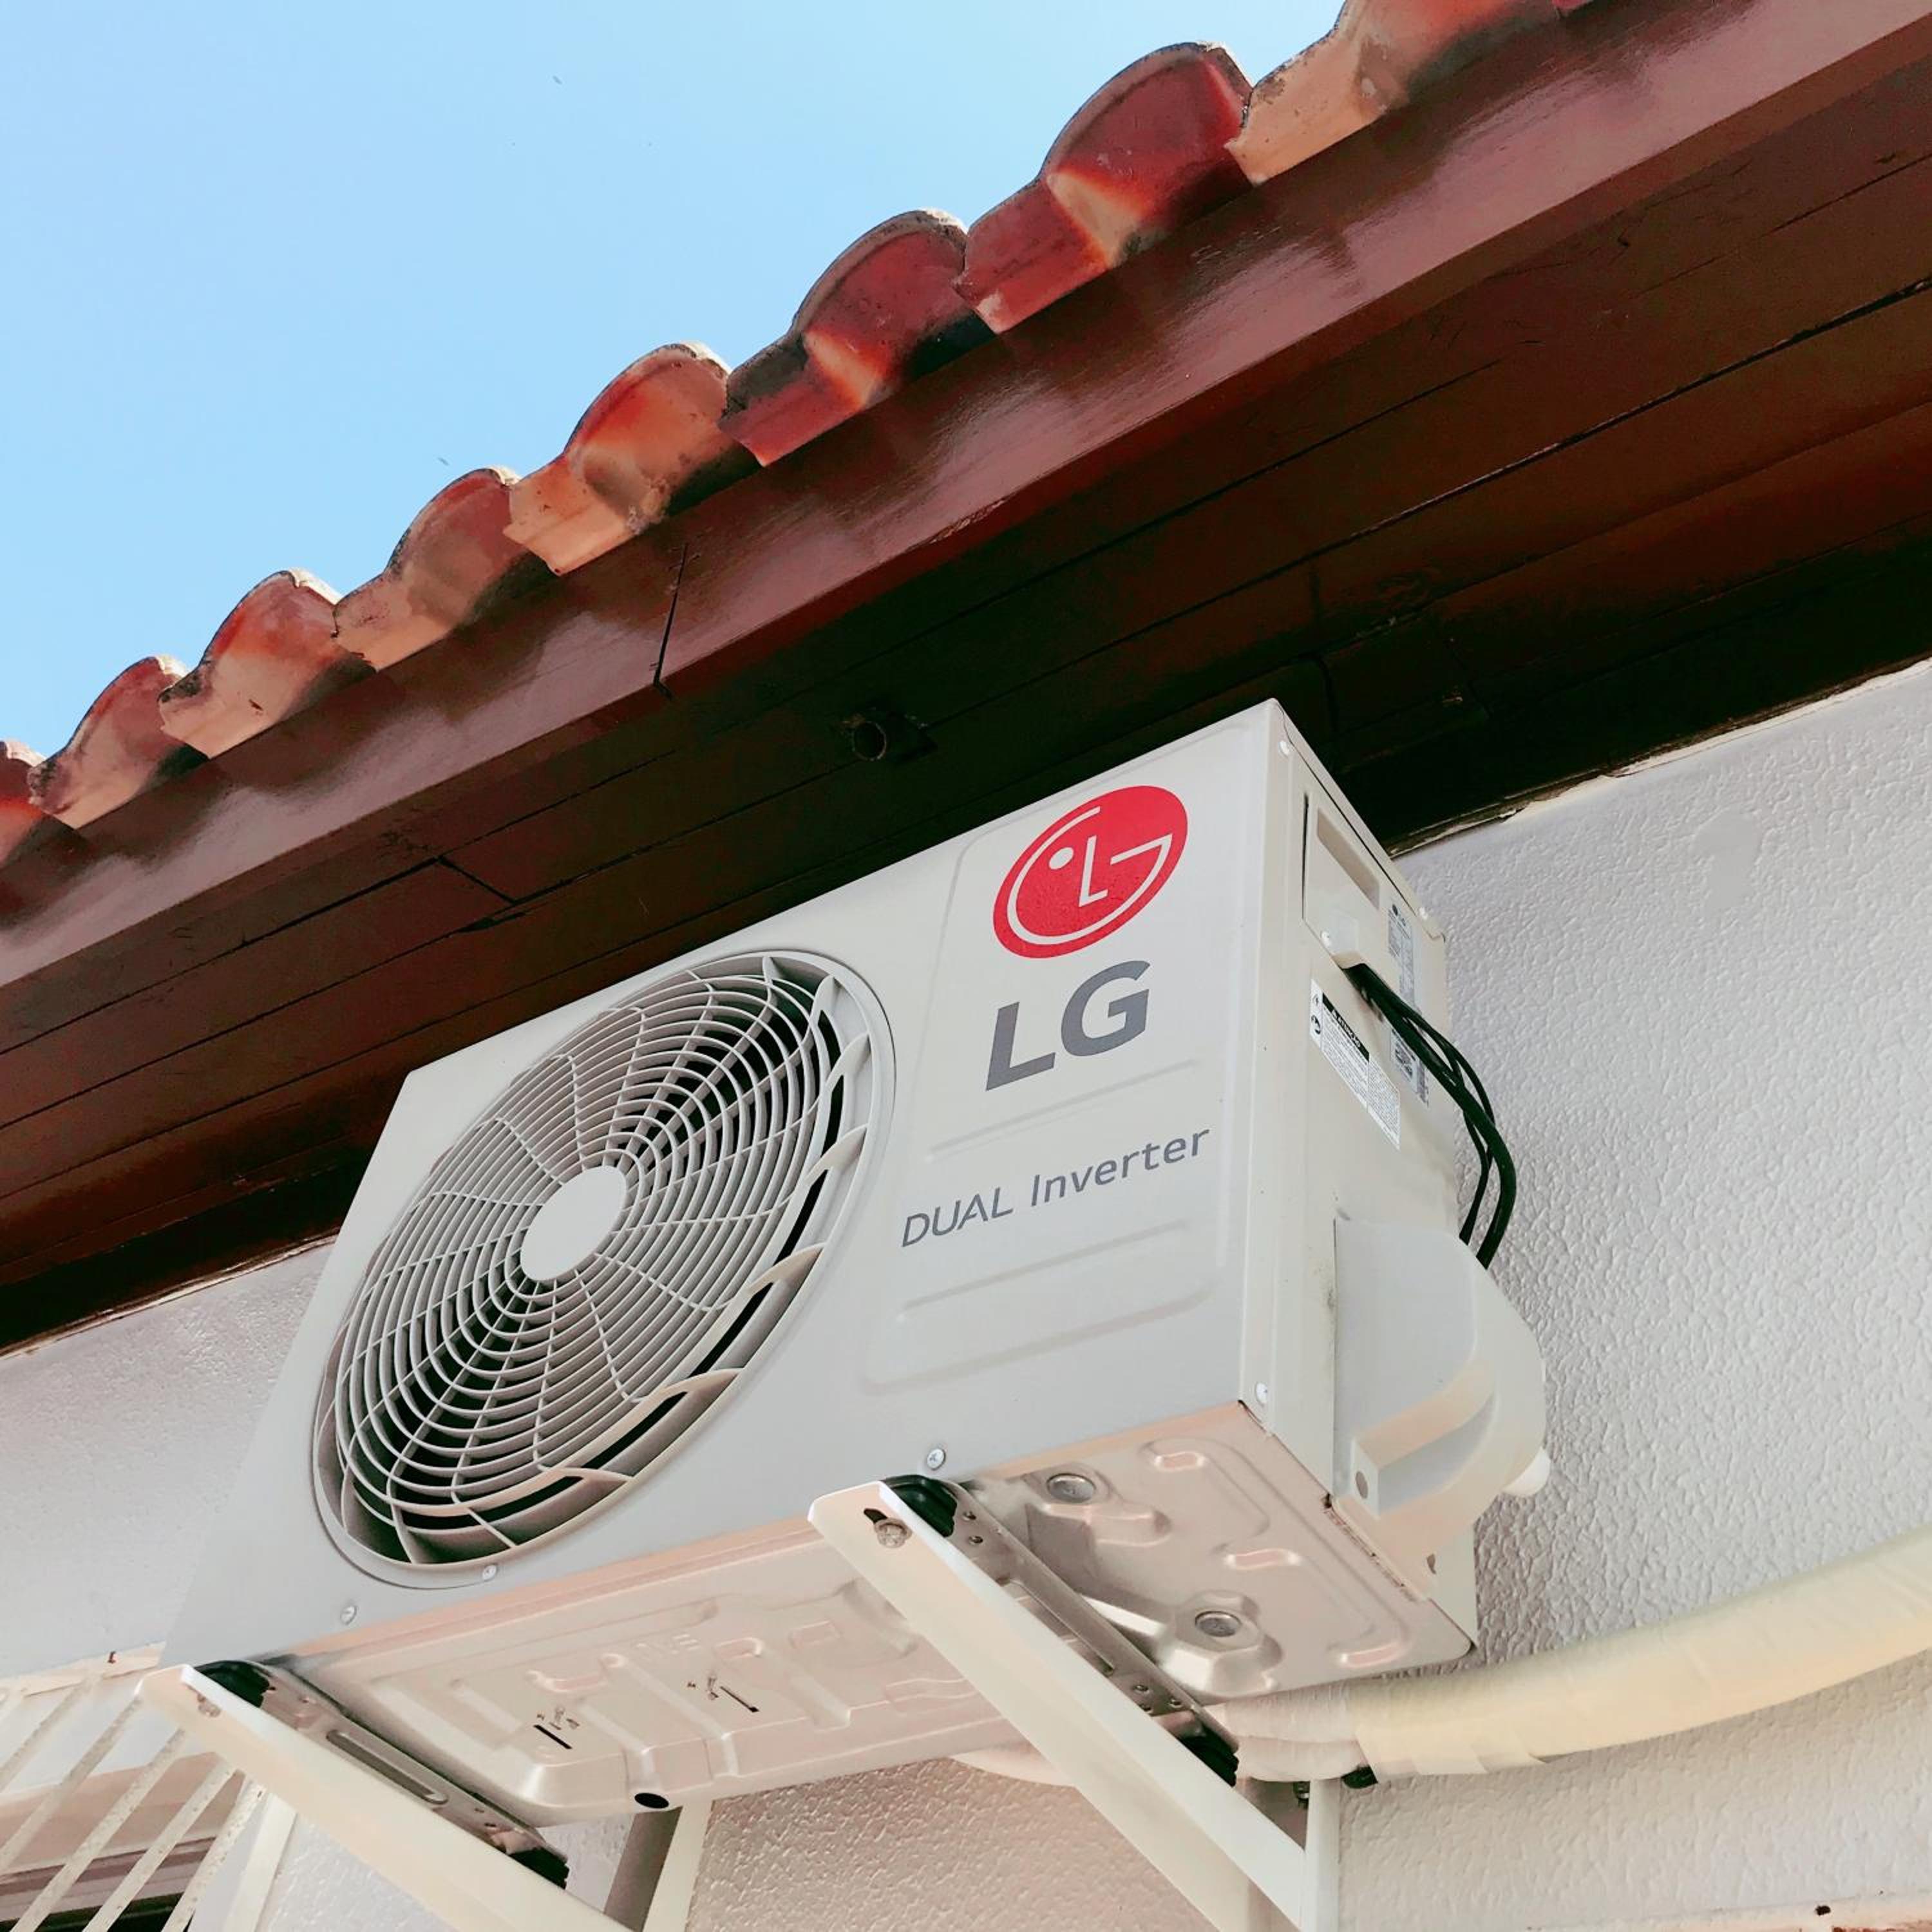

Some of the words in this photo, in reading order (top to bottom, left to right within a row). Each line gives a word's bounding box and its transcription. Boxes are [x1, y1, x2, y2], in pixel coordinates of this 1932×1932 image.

[985, 960, 1151, 1092] LG
[901, 1187, 1014, 1248] DUAL
[1030, 1128, 1211, 1208] Inverter
